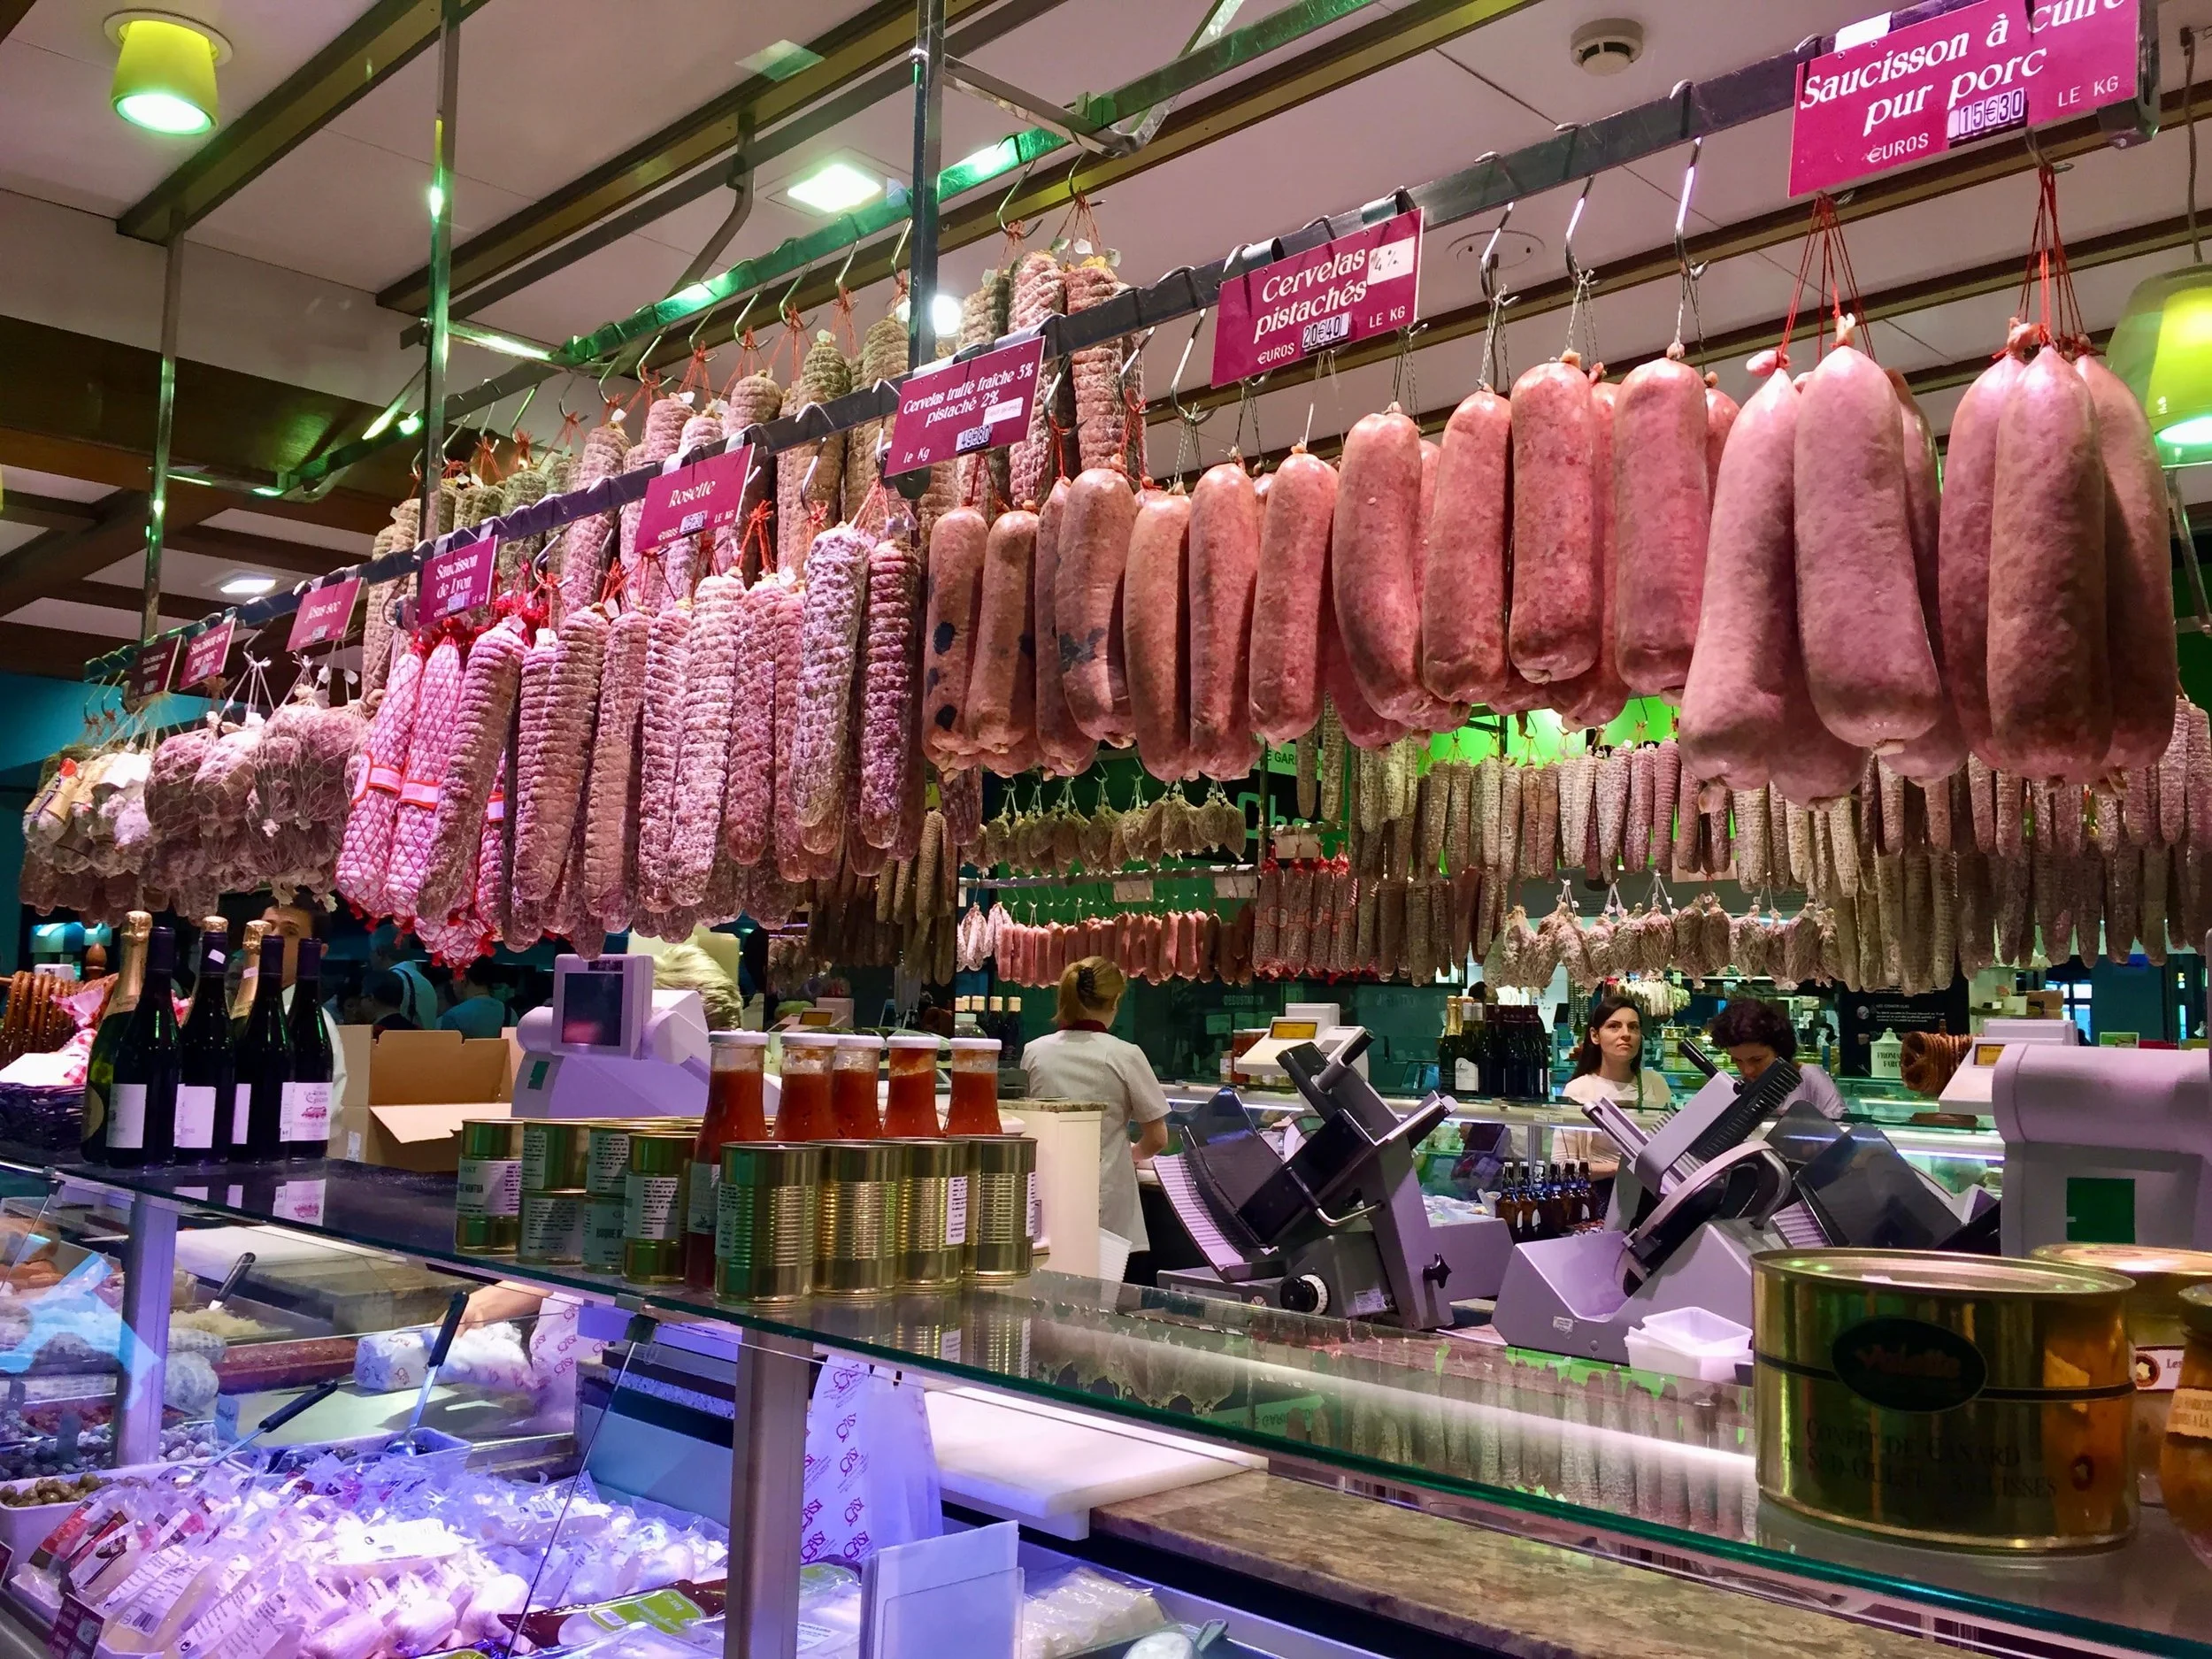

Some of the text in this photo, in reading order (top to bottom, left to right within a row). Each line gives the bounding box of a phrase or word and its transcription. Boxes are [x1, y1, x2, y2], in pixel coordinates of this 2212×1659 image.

[1800, 34, 1968, 110] Saucisson
[1986, 13, 2008, 49] à
[1863, 48, 2047, 137] pur porc
[2057, 86, 2081, 106] LE
[2093, 76, 2119, 96] KG
[1262, 249, 1366, 303] Cervelas
[1254, 280, 1367, 344] pistachés
[1369, 314, 1383, 328] LE
[1389, 305, 1406, 322] KG
[903, 393, 944, 415] Cervelas
[947, 380, 976, 401] truffé
[977, 370, 1015, 392] fraîche
[926, 396, 977, 428] pistaché
[980, 389, 1000, 408] 2%
[668, 480, 716, 508] Rosette
